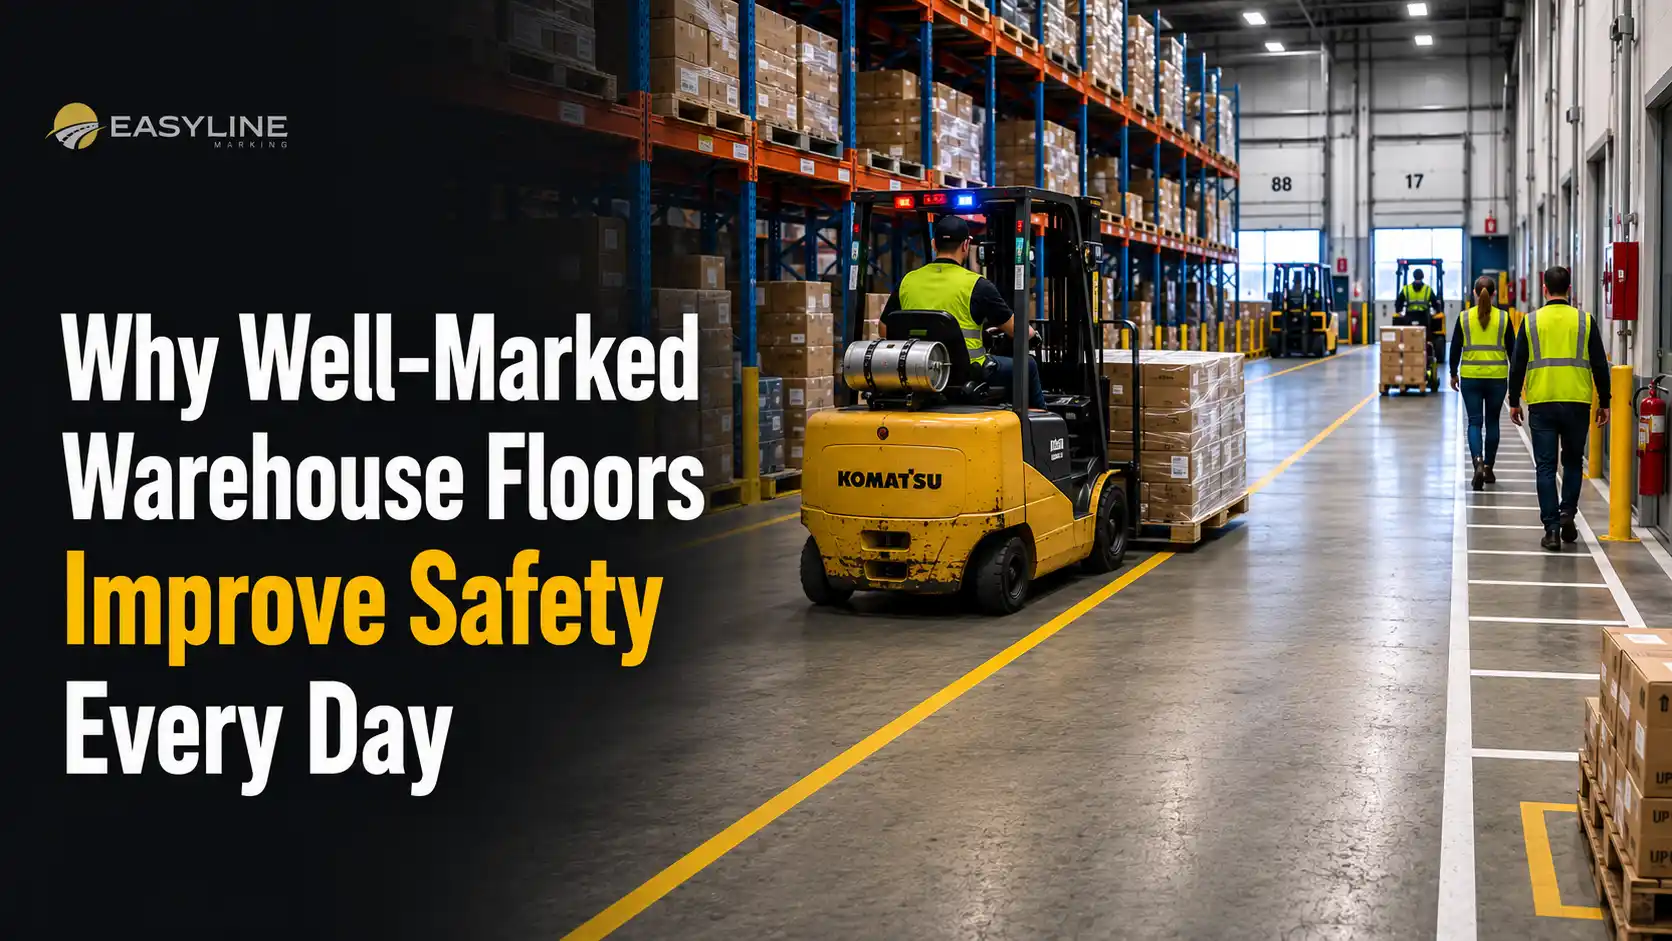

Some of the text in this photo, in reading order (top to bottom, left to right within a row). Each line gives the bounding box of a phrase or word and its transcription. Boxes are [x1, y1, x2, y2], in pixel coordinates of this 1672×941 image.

[1271, 176, 1292, 192] 88
[1405, 173, 1424, 189] 17
[837, 468, 943, 490] KOMATSU
